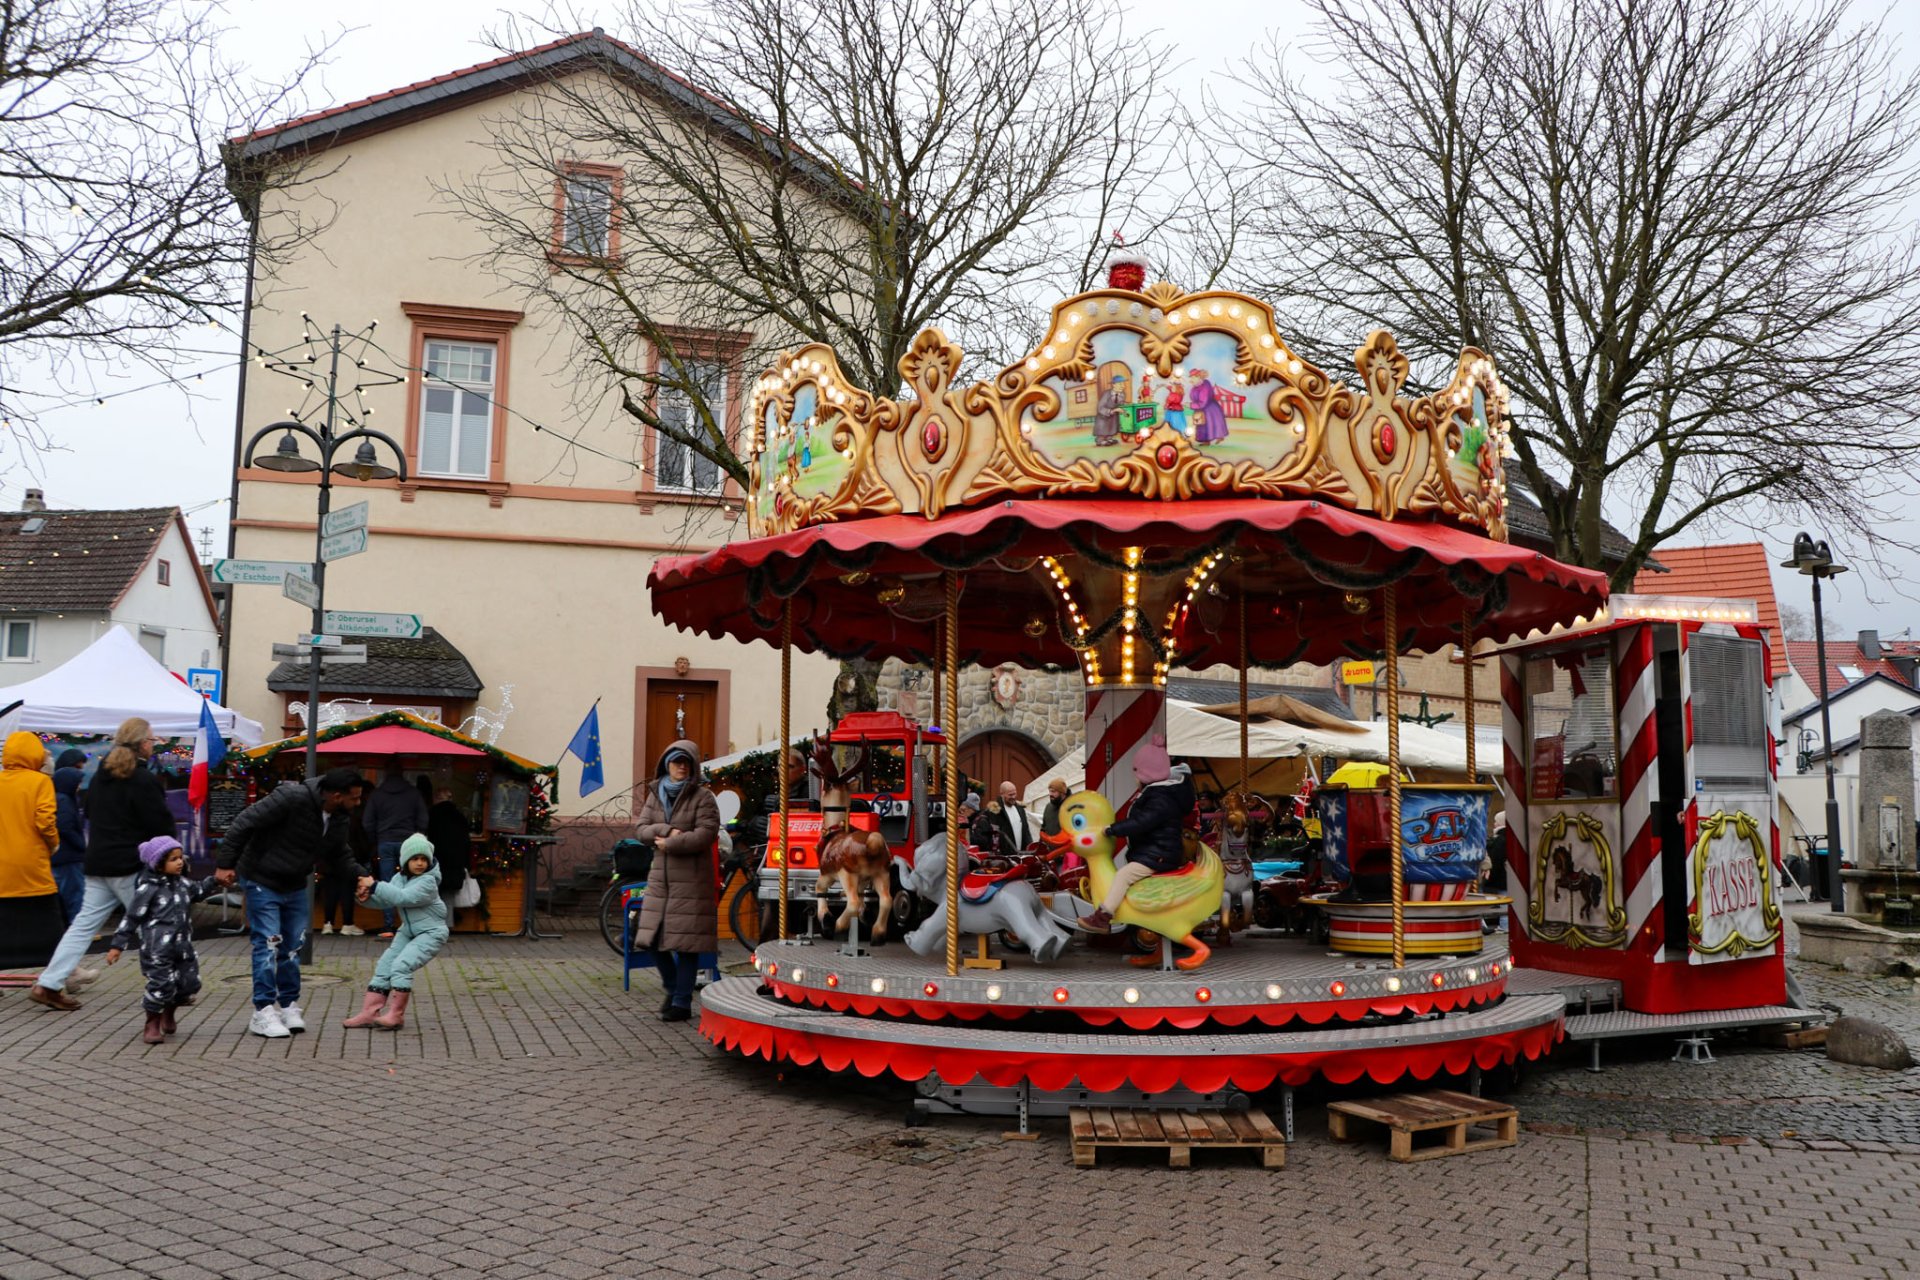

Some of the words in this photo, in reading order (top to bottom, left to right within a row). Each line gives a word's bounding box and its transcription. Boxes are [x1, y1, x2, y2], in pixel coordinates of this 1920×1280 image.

[232, 563, 266, 571] Hofheim
[243, 573, 280, 581] Eschborn
[337, 614, 377, 623] Oberursel
[1352, 667, 1371, 676] LOTTO
[1401, 815, 1468, 846] PAW
[1707, 856, 1758, 917] KASSE
